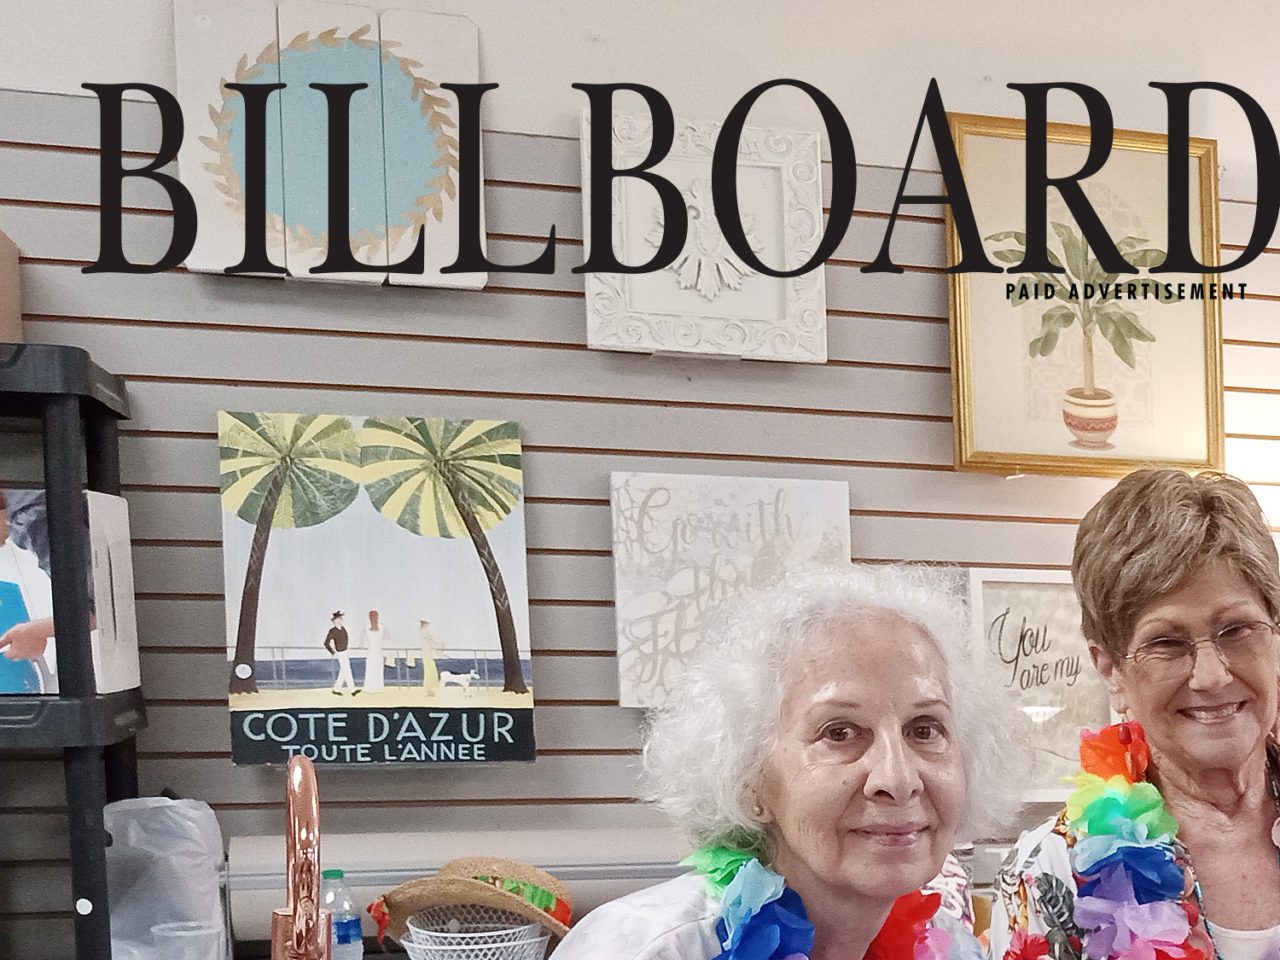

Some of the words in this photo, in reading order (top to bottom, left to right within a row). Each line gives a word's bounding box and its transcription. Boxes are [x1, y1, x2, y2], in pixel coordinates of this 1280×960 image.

[988, 607, 1052, 687] You
[1020, 661, 1050, 690] are
[1053, 655, 1082, 686] my
[243, 712, 348, 742] COTE
[367, 711, 514, 743] D'AZUR
[281, 744, 371, 761] TOUTE
[384, 743, 487, 762] L'ANNEE
